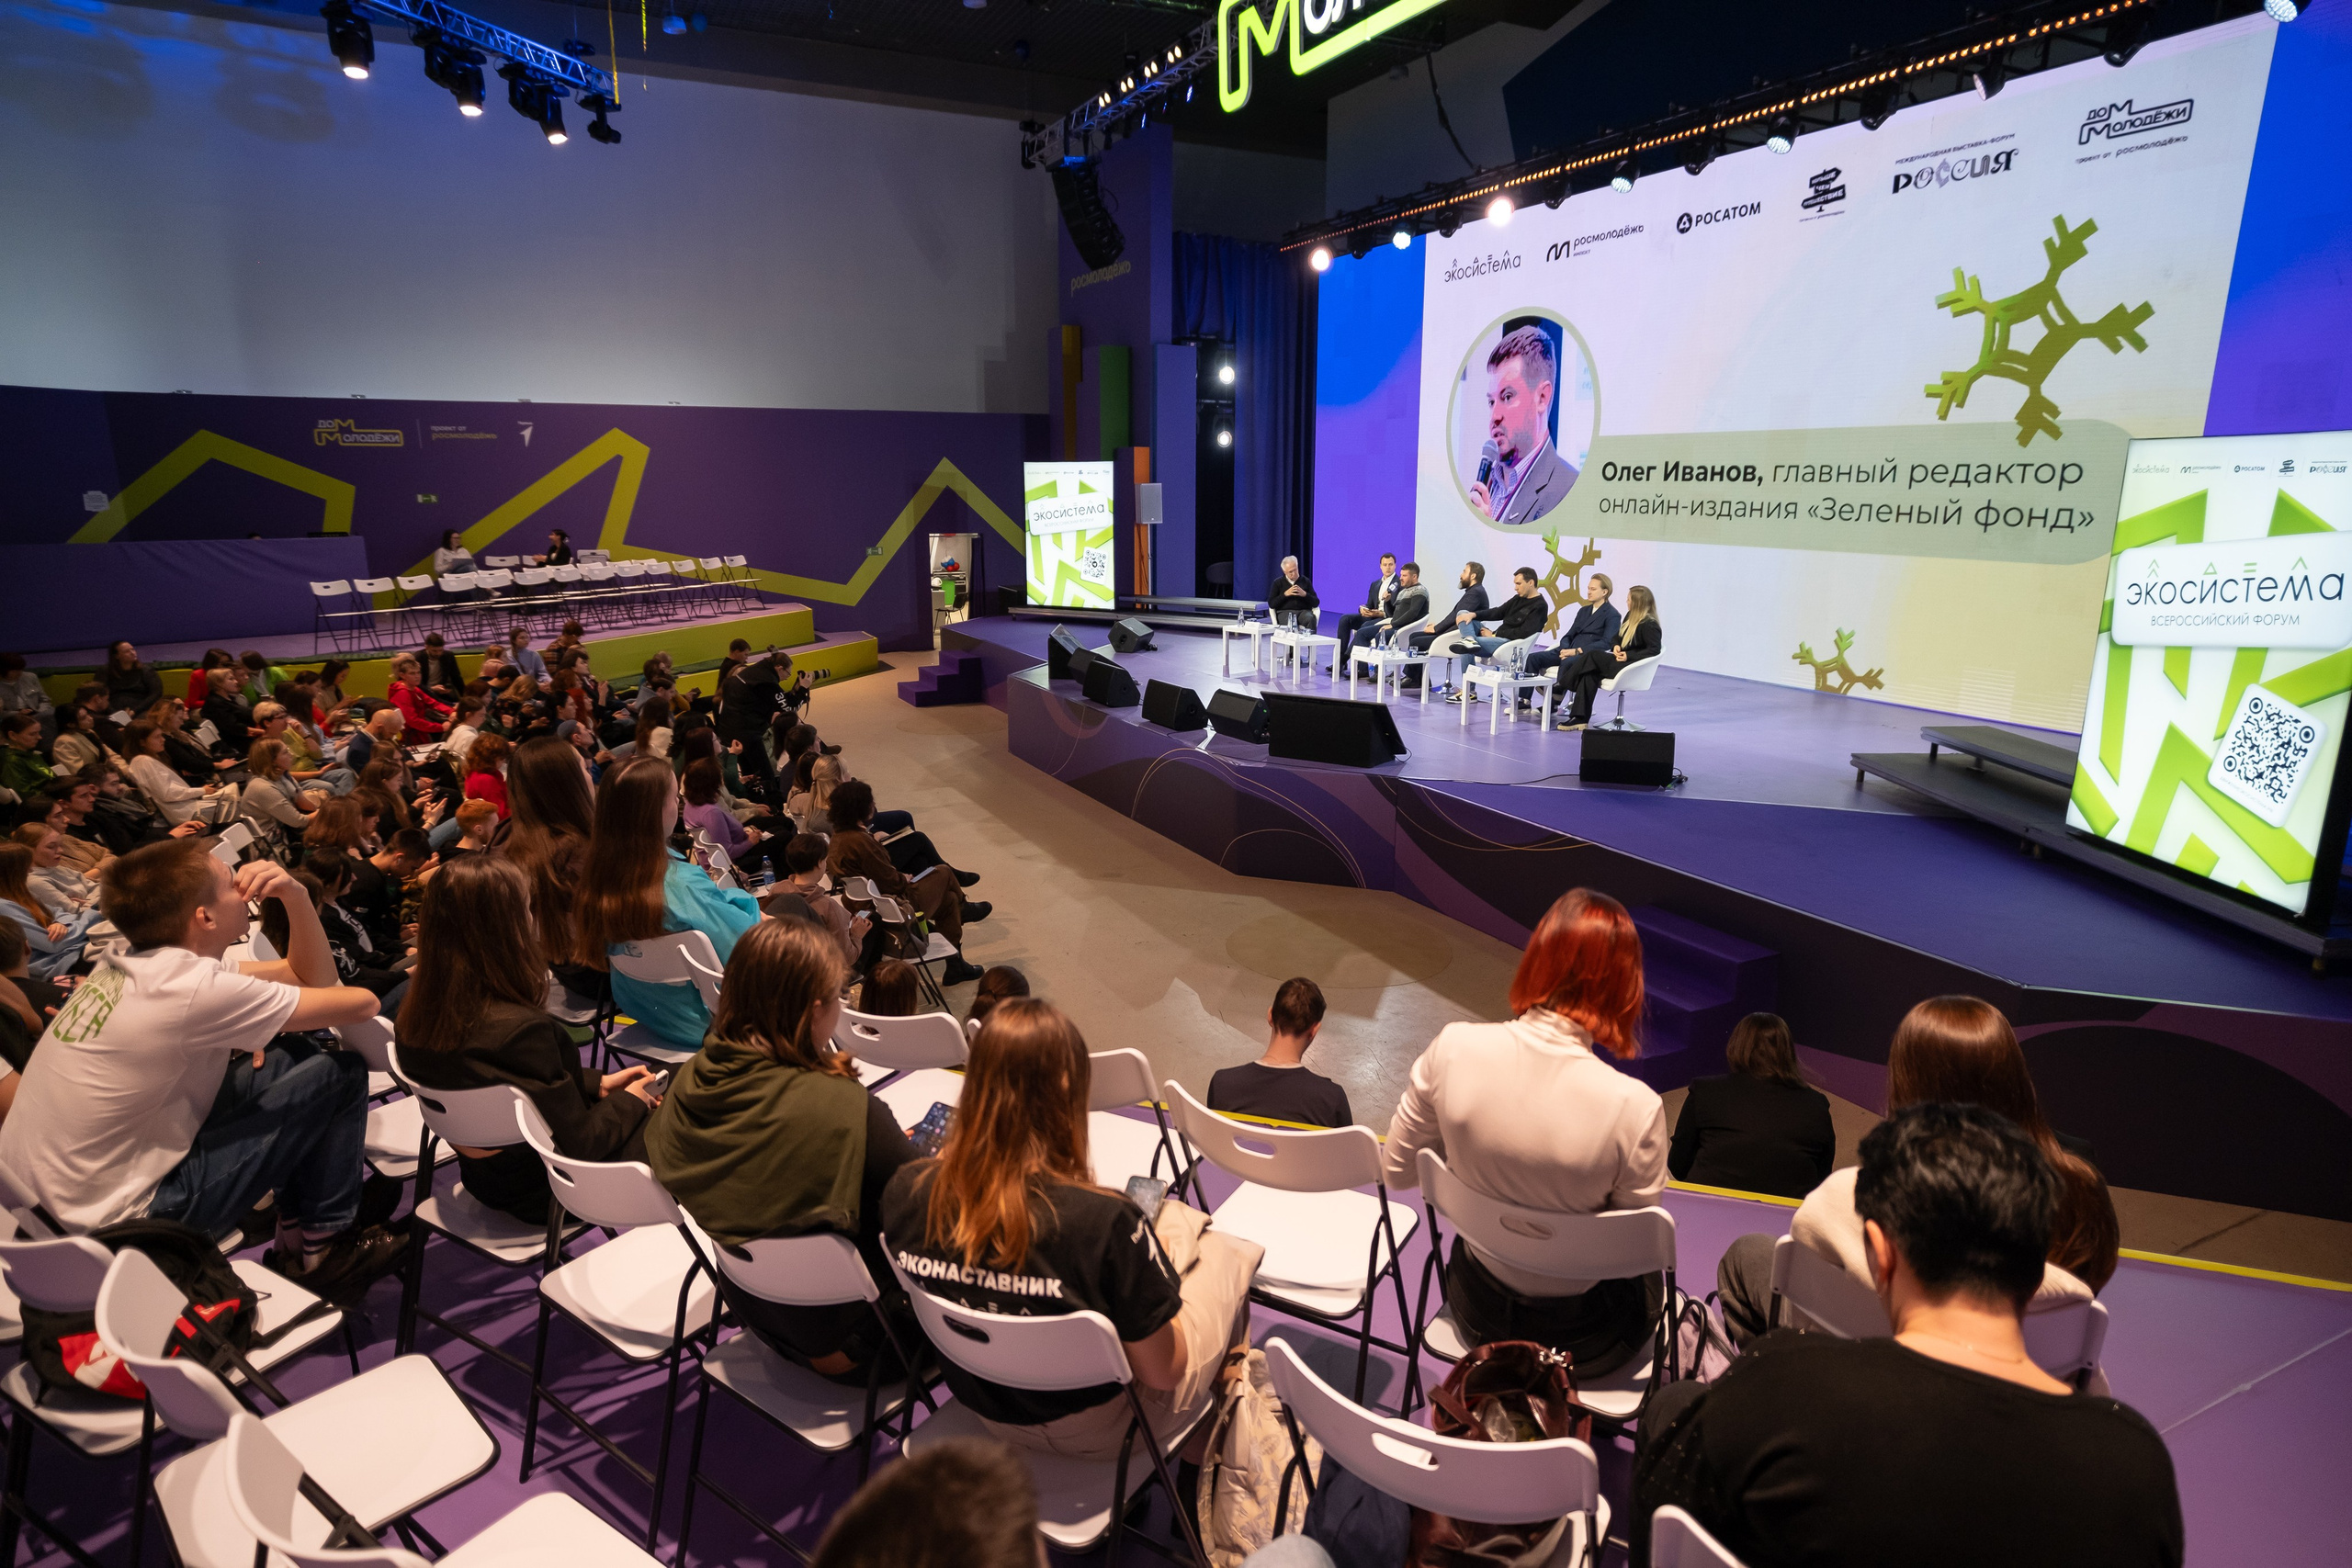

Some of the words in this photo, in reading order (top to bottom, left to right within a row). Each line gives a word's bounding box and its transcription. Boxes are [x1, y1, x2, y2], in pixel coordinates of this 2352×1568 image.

[2078, 107, 2188, 145] МОЛОДЁЖИ
[2086, 98, 2132, 121] ДОМ
[1892, 148, 2020, 194] РОССИЯ
[1695, 201, 1762, 228] РОСАТОМ
[1601, 461, 1657, 484] Олег
[1663, 461, 1764, 488] Иванов,
[1772, 458, 1897, 485] главный
[1908, 460, 2084, 491] редактор
[1599, 493, 1798, 521] онлайн-издания
[1807, 497, 1962, 526] «Зеленый
[1973, 500, 2095, 533] фонд»
[2150, 613, 2250, 627] ВСЕРОССИЙСКИЙ
[2253, 613, 2301, 626] ФОРУМ
[896, 1250, 1064, 1299] ЭКОНАСТАВНИК
